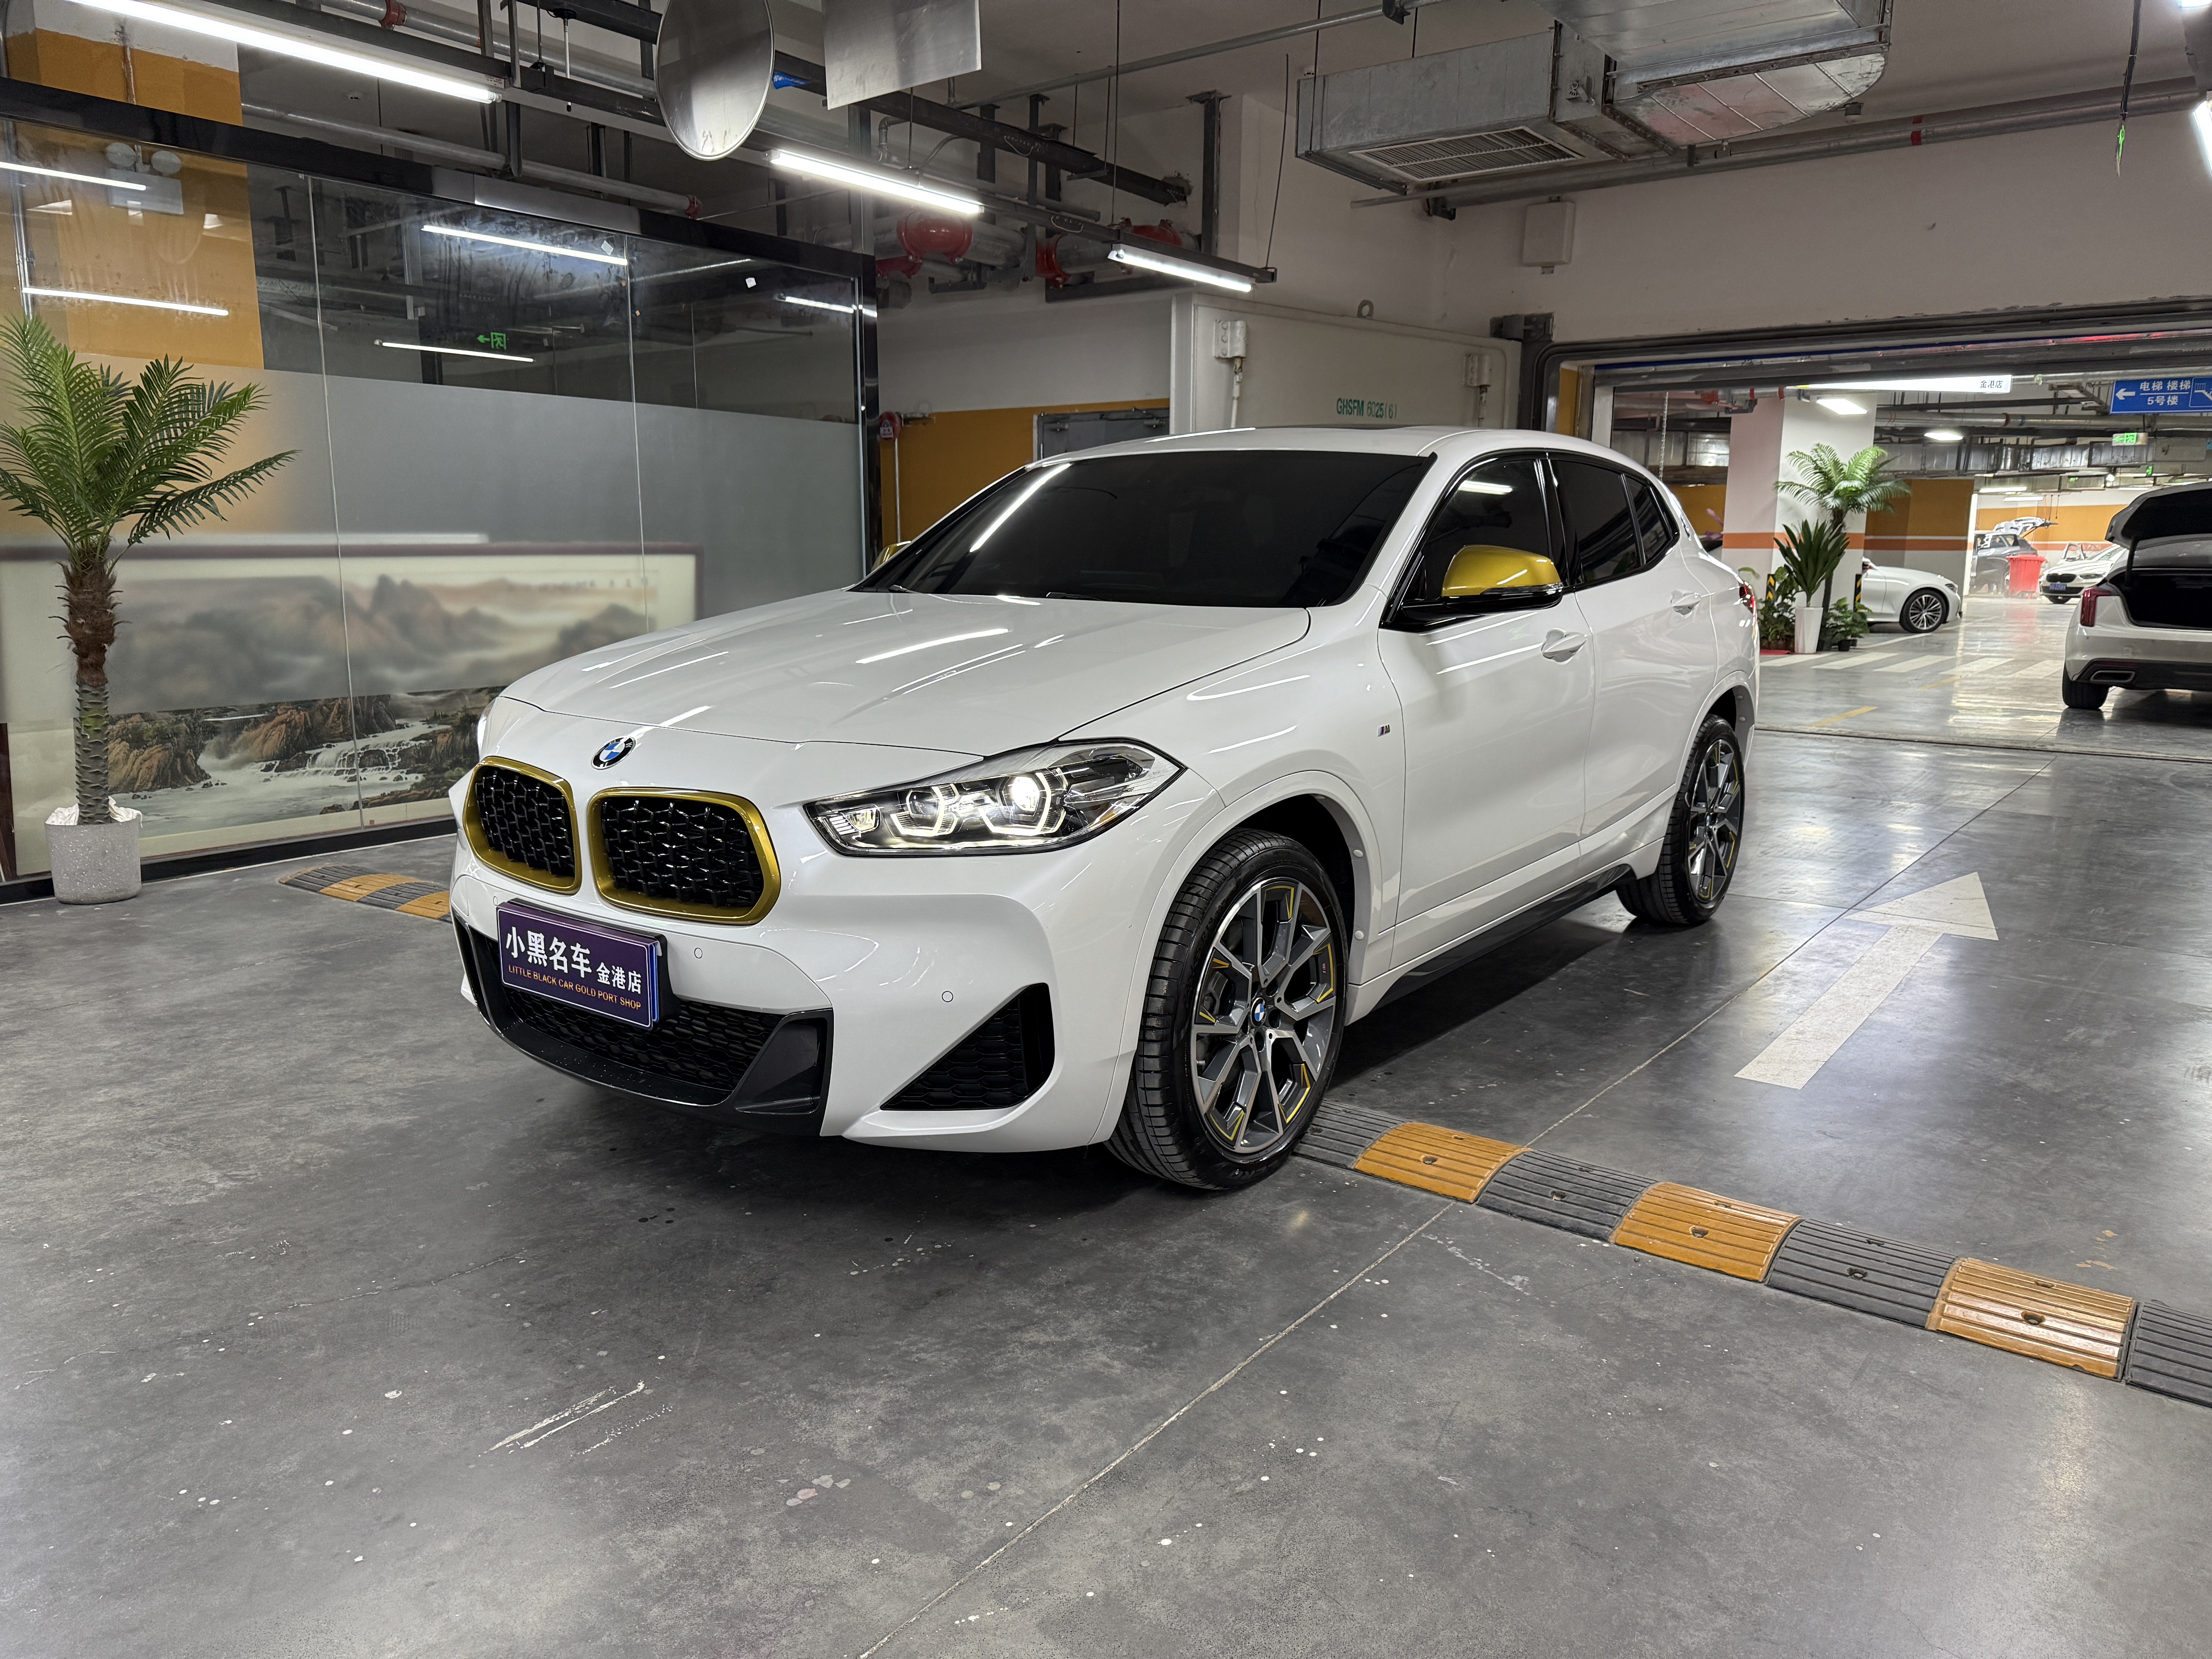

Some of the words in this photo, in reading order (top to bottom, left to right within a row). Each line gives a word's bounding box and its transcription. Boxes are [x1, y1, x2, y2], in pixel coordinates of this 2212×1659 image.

[2140, 380, 2163, 391] 电梯
[2167, 380, 2191, 390] 楼梯
[1336, 398, 1364, 416] GHSFM
[2147, 395, 2178, 405] 5号楼
[506, 926, 592, 978] 小黑名车
[596, 962, 641, 994] 金港店
[508, 964, 532, 978] LITTLE
[533, 972, 556, 986] BLACK
[558, 979, 573, 990] CAR
[576, 984, 596, 997] GOLD
[598, 991, 618, 1003] PORT
[620, 997, 641, 1010] SHOP
